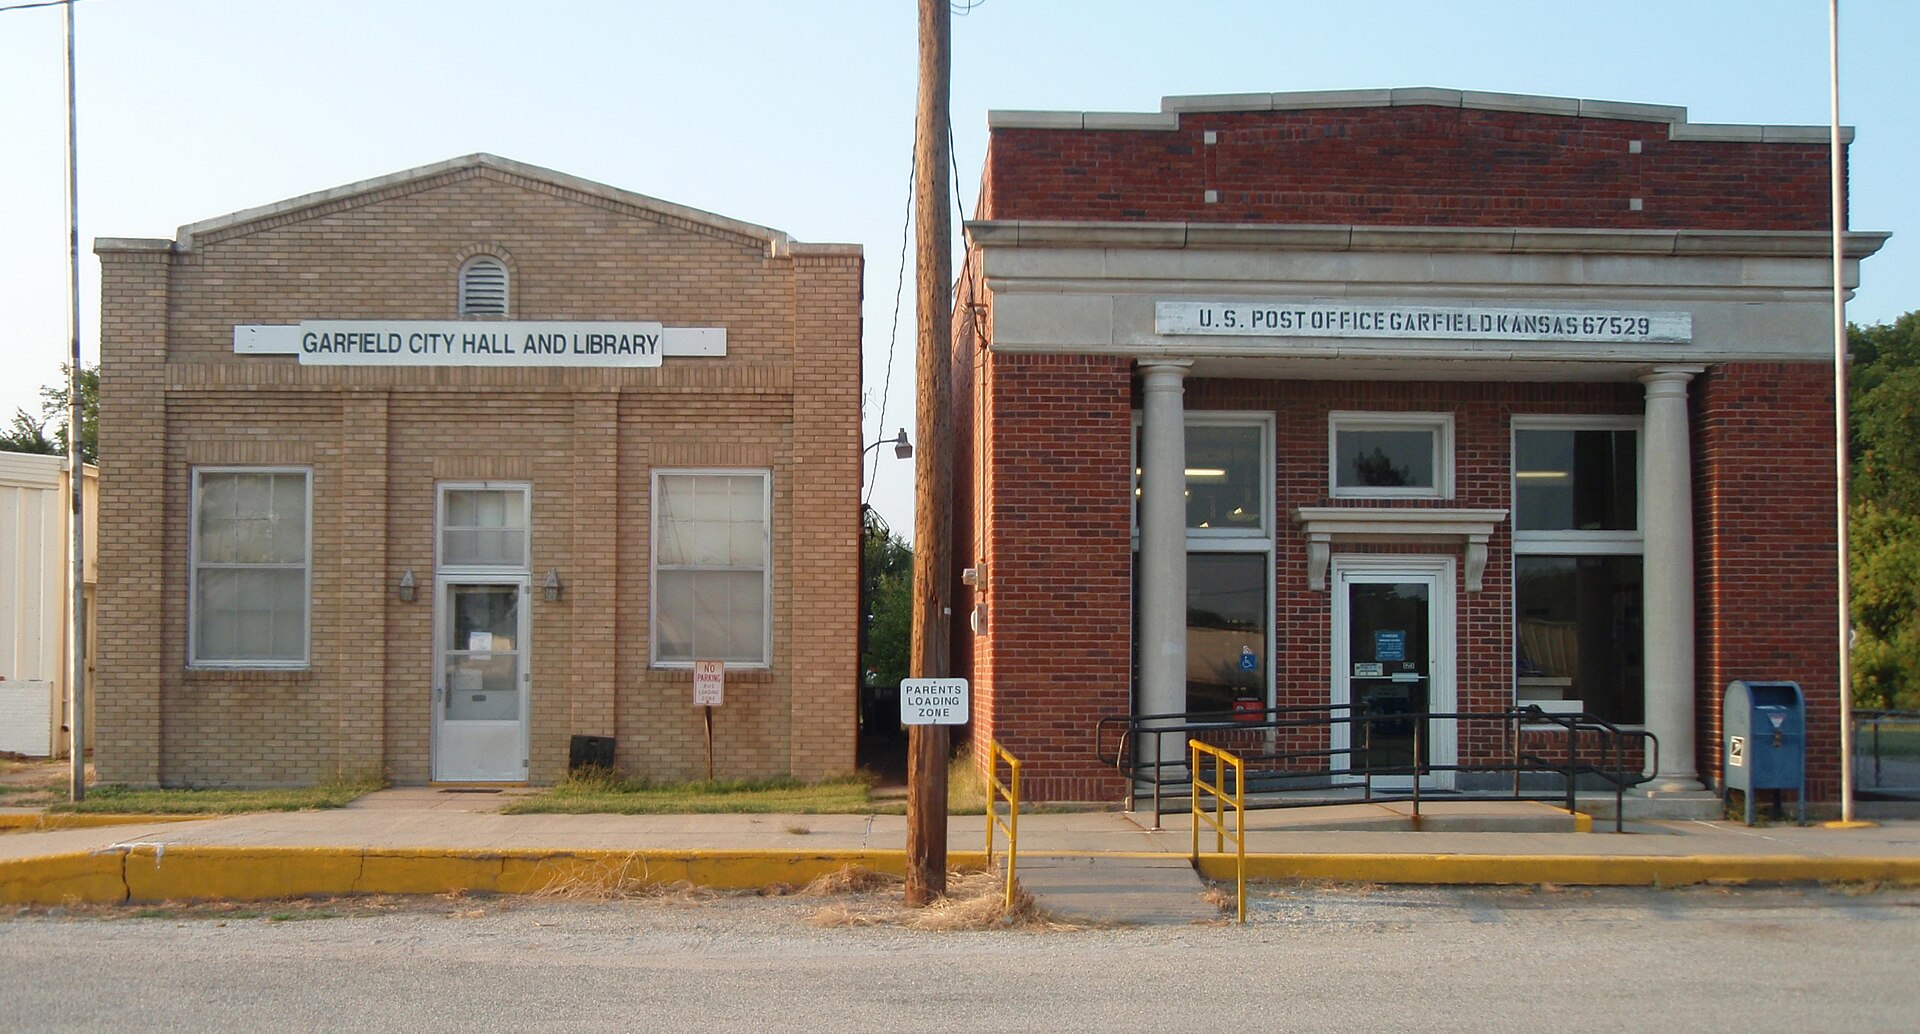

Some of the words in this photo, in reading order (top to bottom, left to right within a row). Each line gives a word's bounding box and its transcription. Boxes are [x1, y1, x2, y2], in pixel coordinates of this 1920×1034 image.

[1199, 309, 1244, 328] U.S.
[1252, 310, 1306, 330] POST
[1311, 311, 1385, 331] OFFICE
[1389, 313, 1492, 333] GARFIELD
[1497, 314, 1579, 335] KANSAS
[1582, 316, 1650, 336] 67529
[302, 332, 403, 354] GARFIELD
[408, 333, 455, 354] CITY
[461, 333, 516, 355] HALL
[523, 333, 567, 355] AND
[573, 333, 660, 356] LIBRARY
[704, 664, 715, 673] NO
[697, 674, 721, 682] PARKING
[906, 686, 961, 695] PARENTS
[908, 697, 960, 706] LOADING
[918, 708, 950, 717] ZONE
